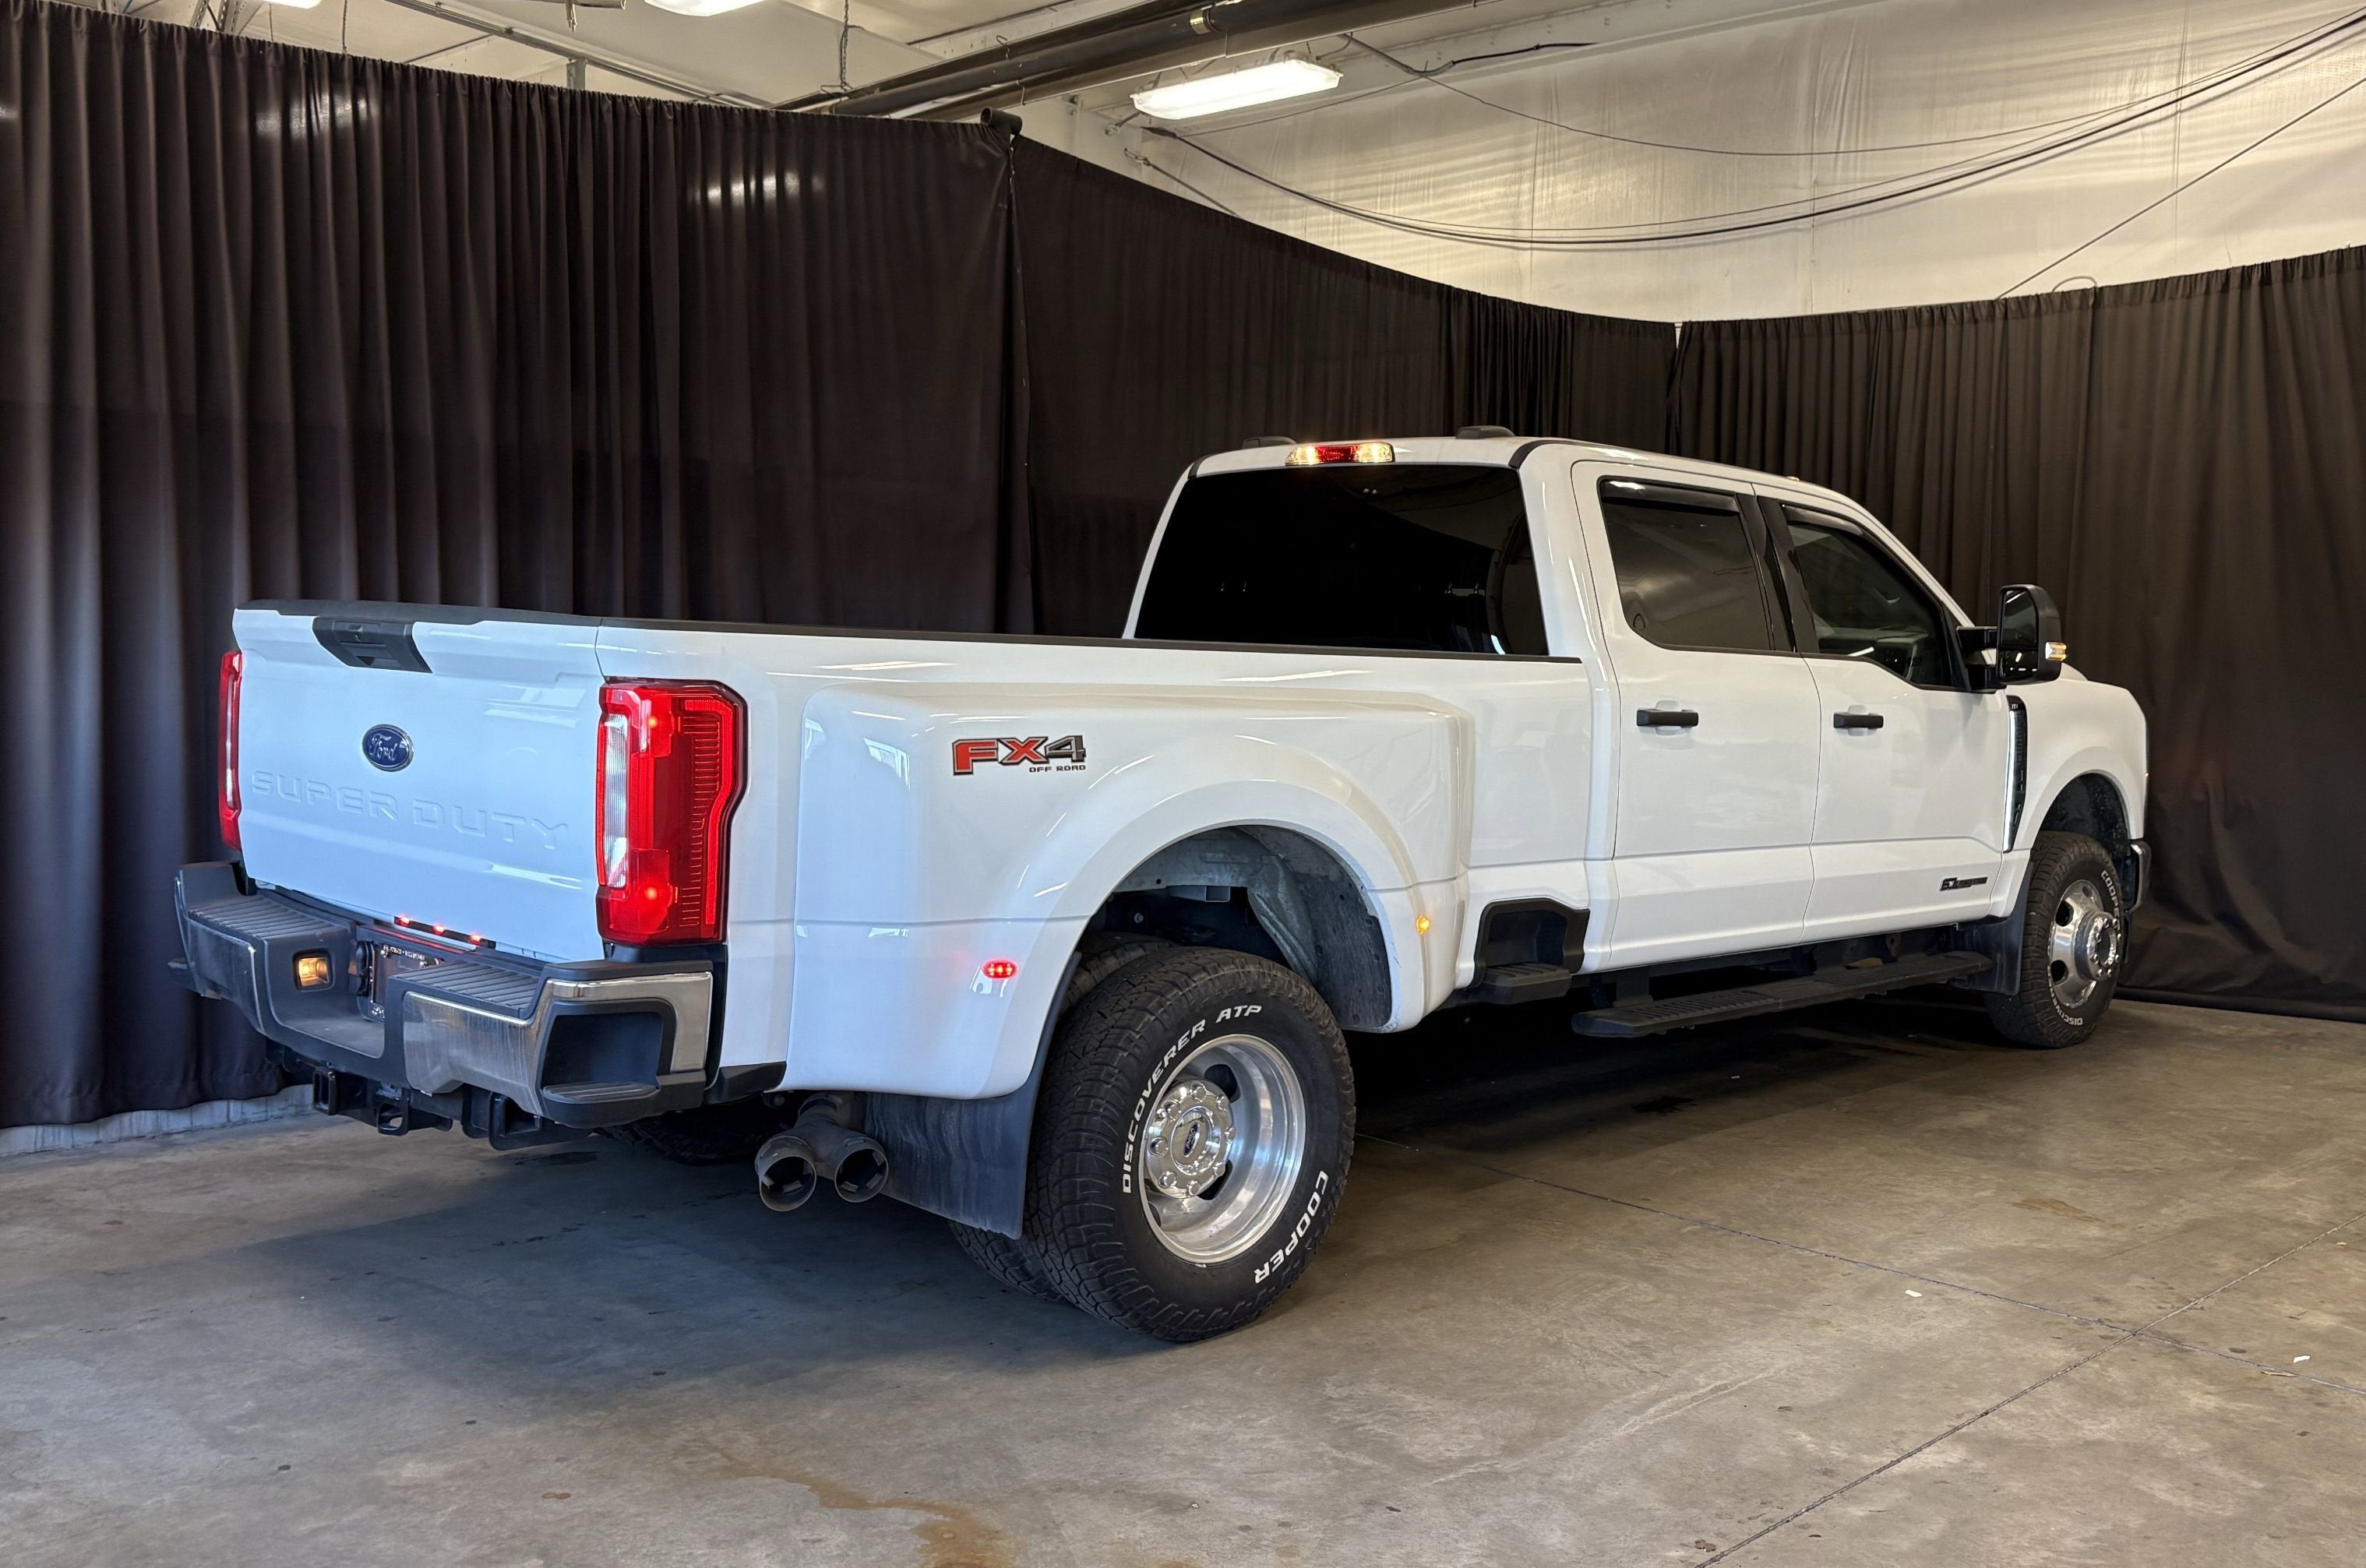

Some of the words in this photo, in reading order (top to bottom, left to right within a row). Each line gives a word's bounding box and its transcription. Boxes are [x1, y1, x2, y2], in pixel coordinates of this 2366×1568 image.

[952, 735, 1087, 776] FX4
[252, 770, 399, 821] SUPER
[413, 798, 569, 851] DUTY
[1122, 1019, 1206, 1194] DISCOVERER
[1215, 1004, 1263, 1024] ATP
[1254, 1171, 1329, 1284] COOPER
